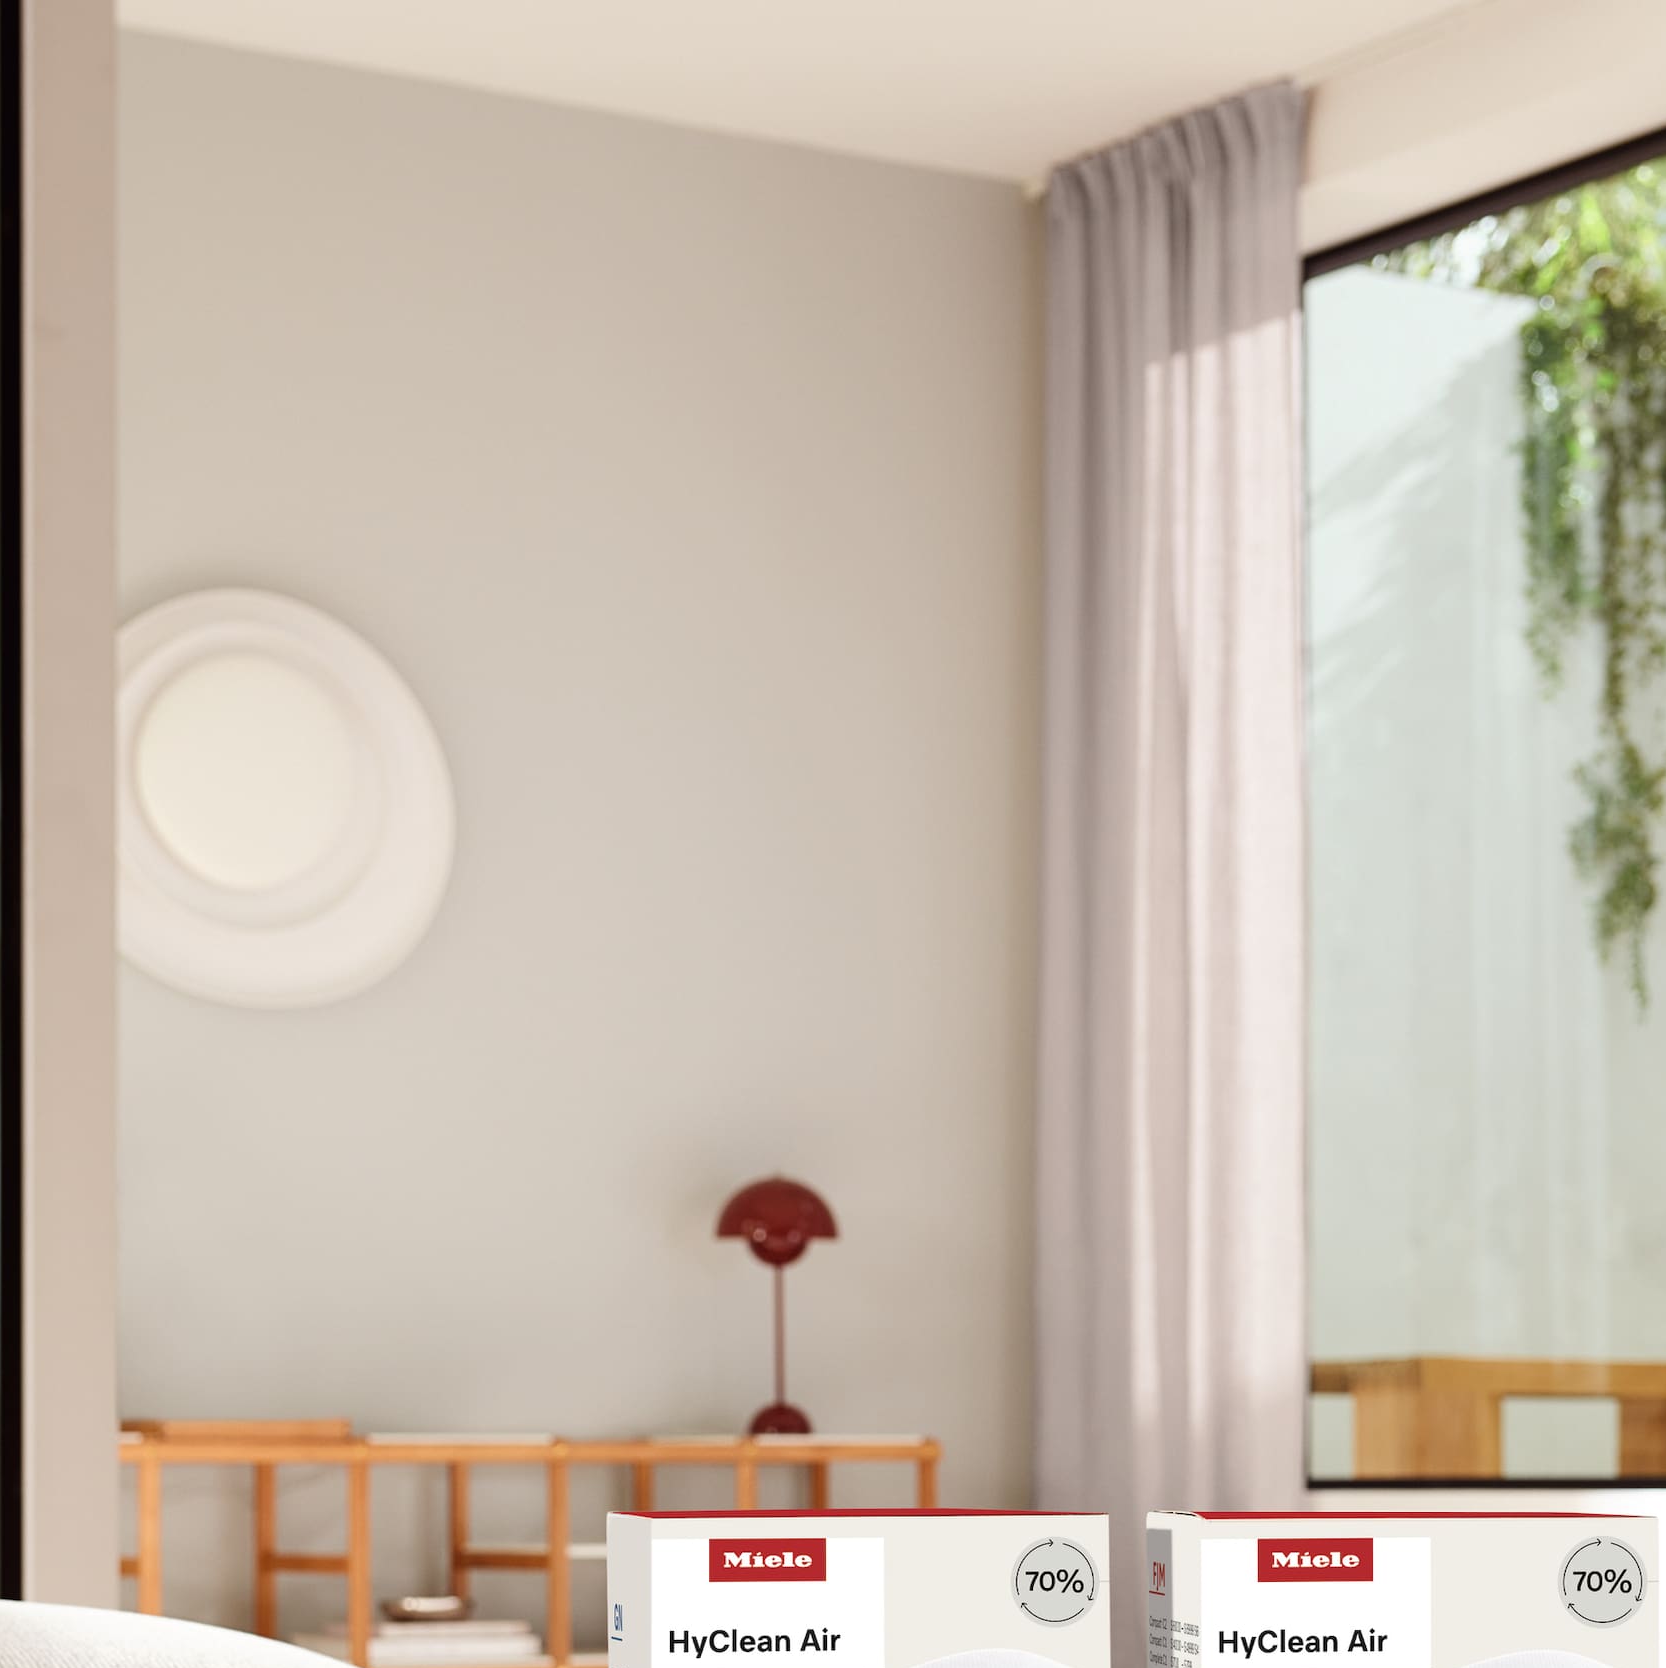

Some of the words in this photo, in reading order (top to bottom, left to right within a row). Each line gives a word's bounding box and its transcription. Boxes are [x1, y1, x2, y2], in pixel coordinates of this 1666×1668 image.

[723, 1551, 813, 1569] Miele
[1271, 1551, 1360, 1569] Miele
[1025, 1569, 1085, 1594] 70%
[1152, 1561, 1166, 1590] FJM
[1573, 1569, 1632, 1594] 70%
[613, 1603, 623, 1632] GN
[668, 1628, 791, 1660] HyClean
[799, 1627, 842, 1652] Air
[1218, 1628, 1339, 1660] HyClean
[1347, 1627, 1389, 1653] Air
